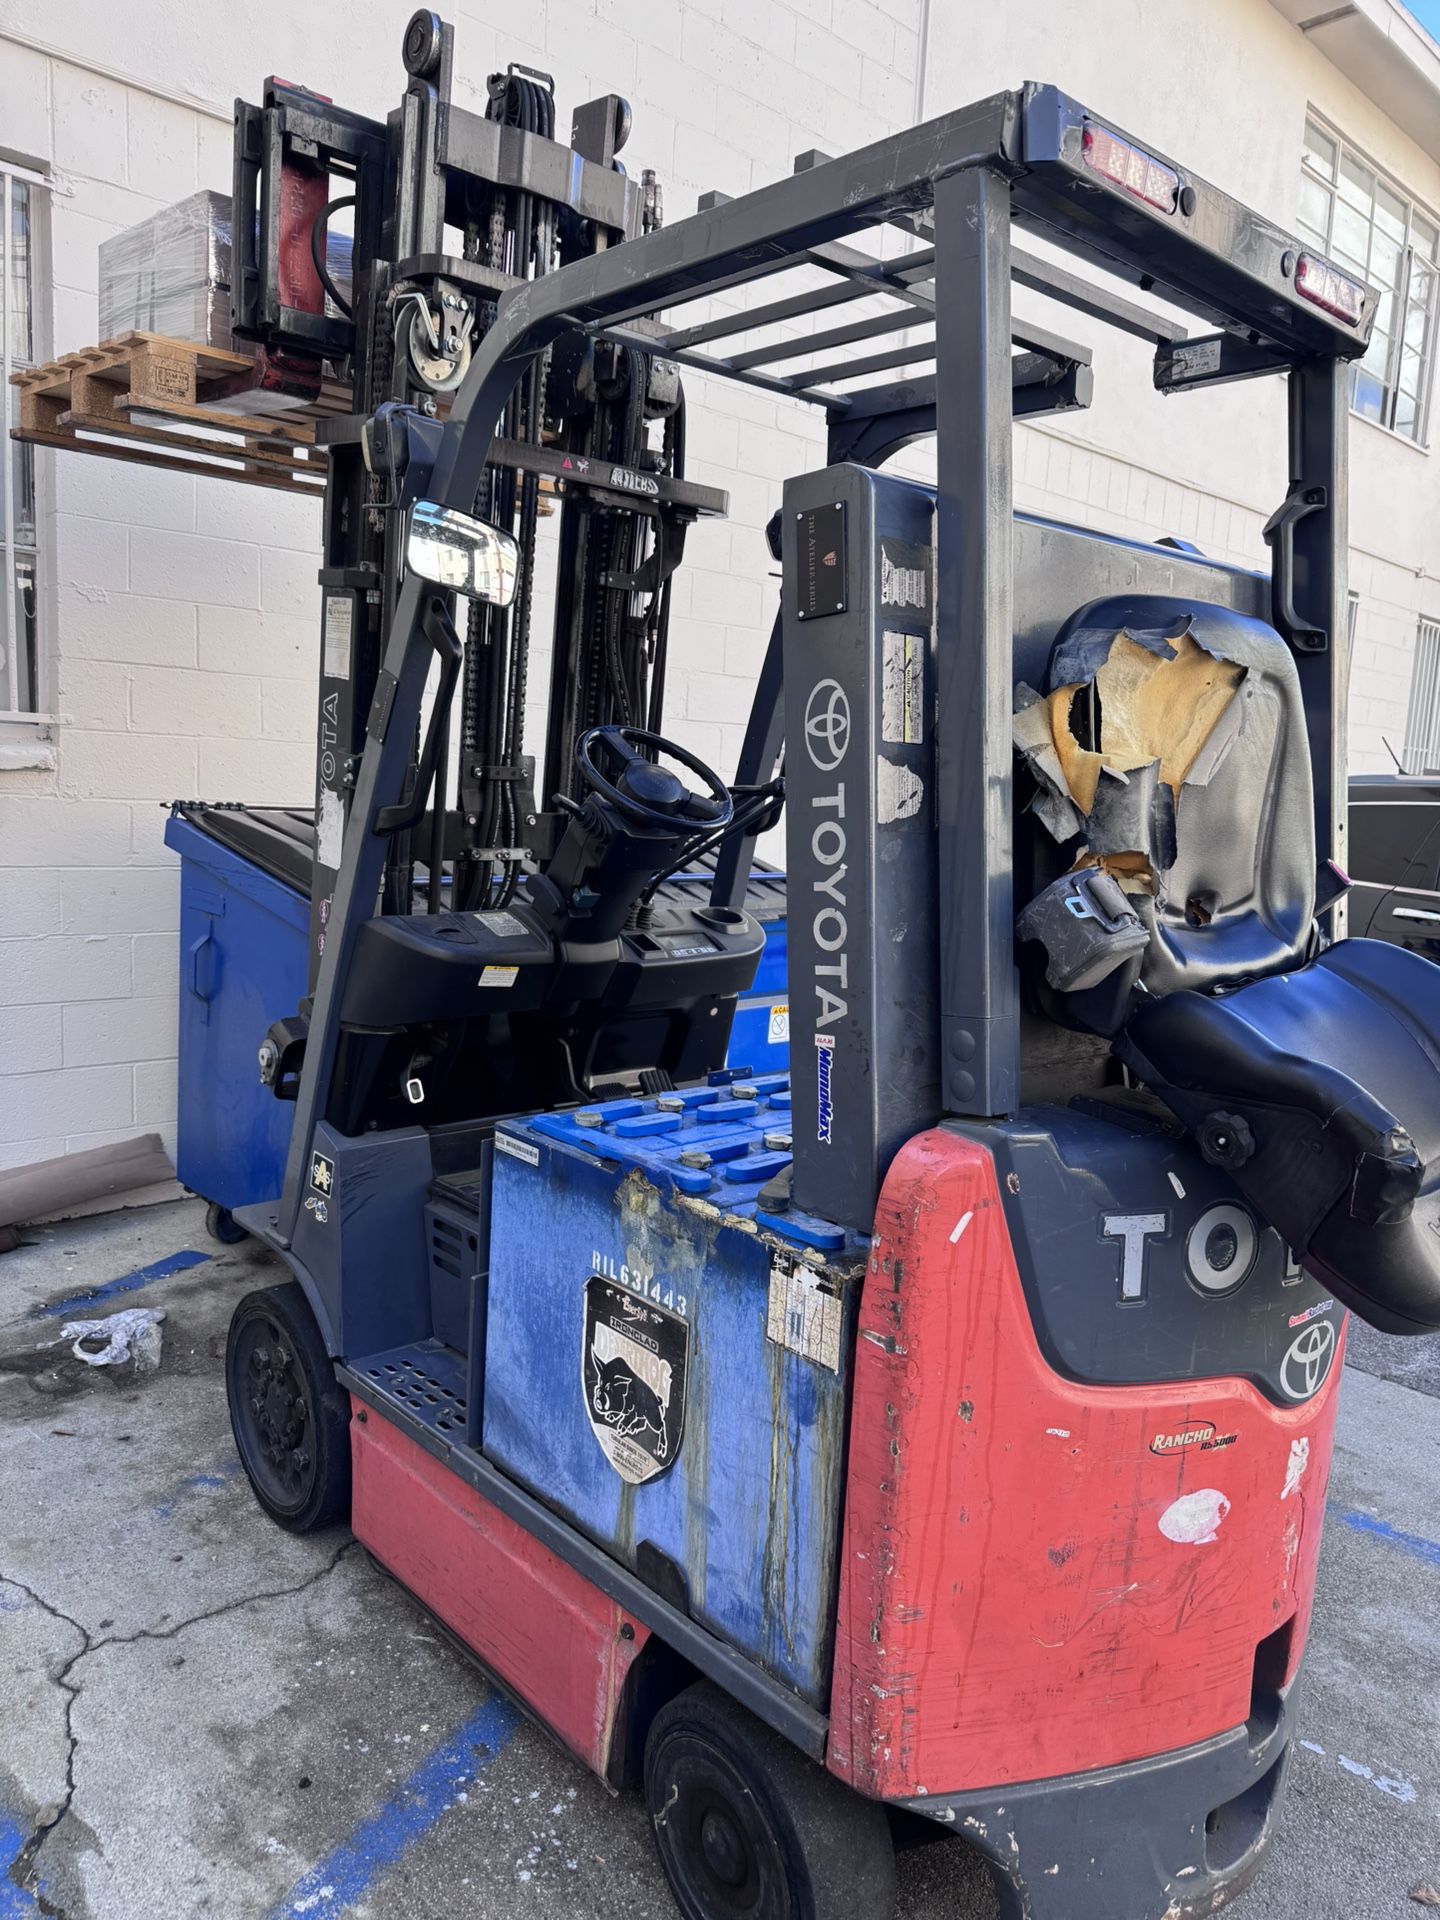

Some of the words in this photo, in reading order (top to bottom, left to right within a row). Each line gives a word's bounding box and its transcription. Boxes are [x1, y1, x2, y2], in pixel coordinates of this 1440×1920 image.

[808, 537, 816, 579] ATELIER
[811, 782, 848, 1029] TOYOTA
[817, 1047, 834, 1144] MonoMax
[1103, 1204, 1303, 1298] TO
[611, 1318, 658, 1351] IRONCLAD
[1153, 1427, 1214, 1450] RANCHO
